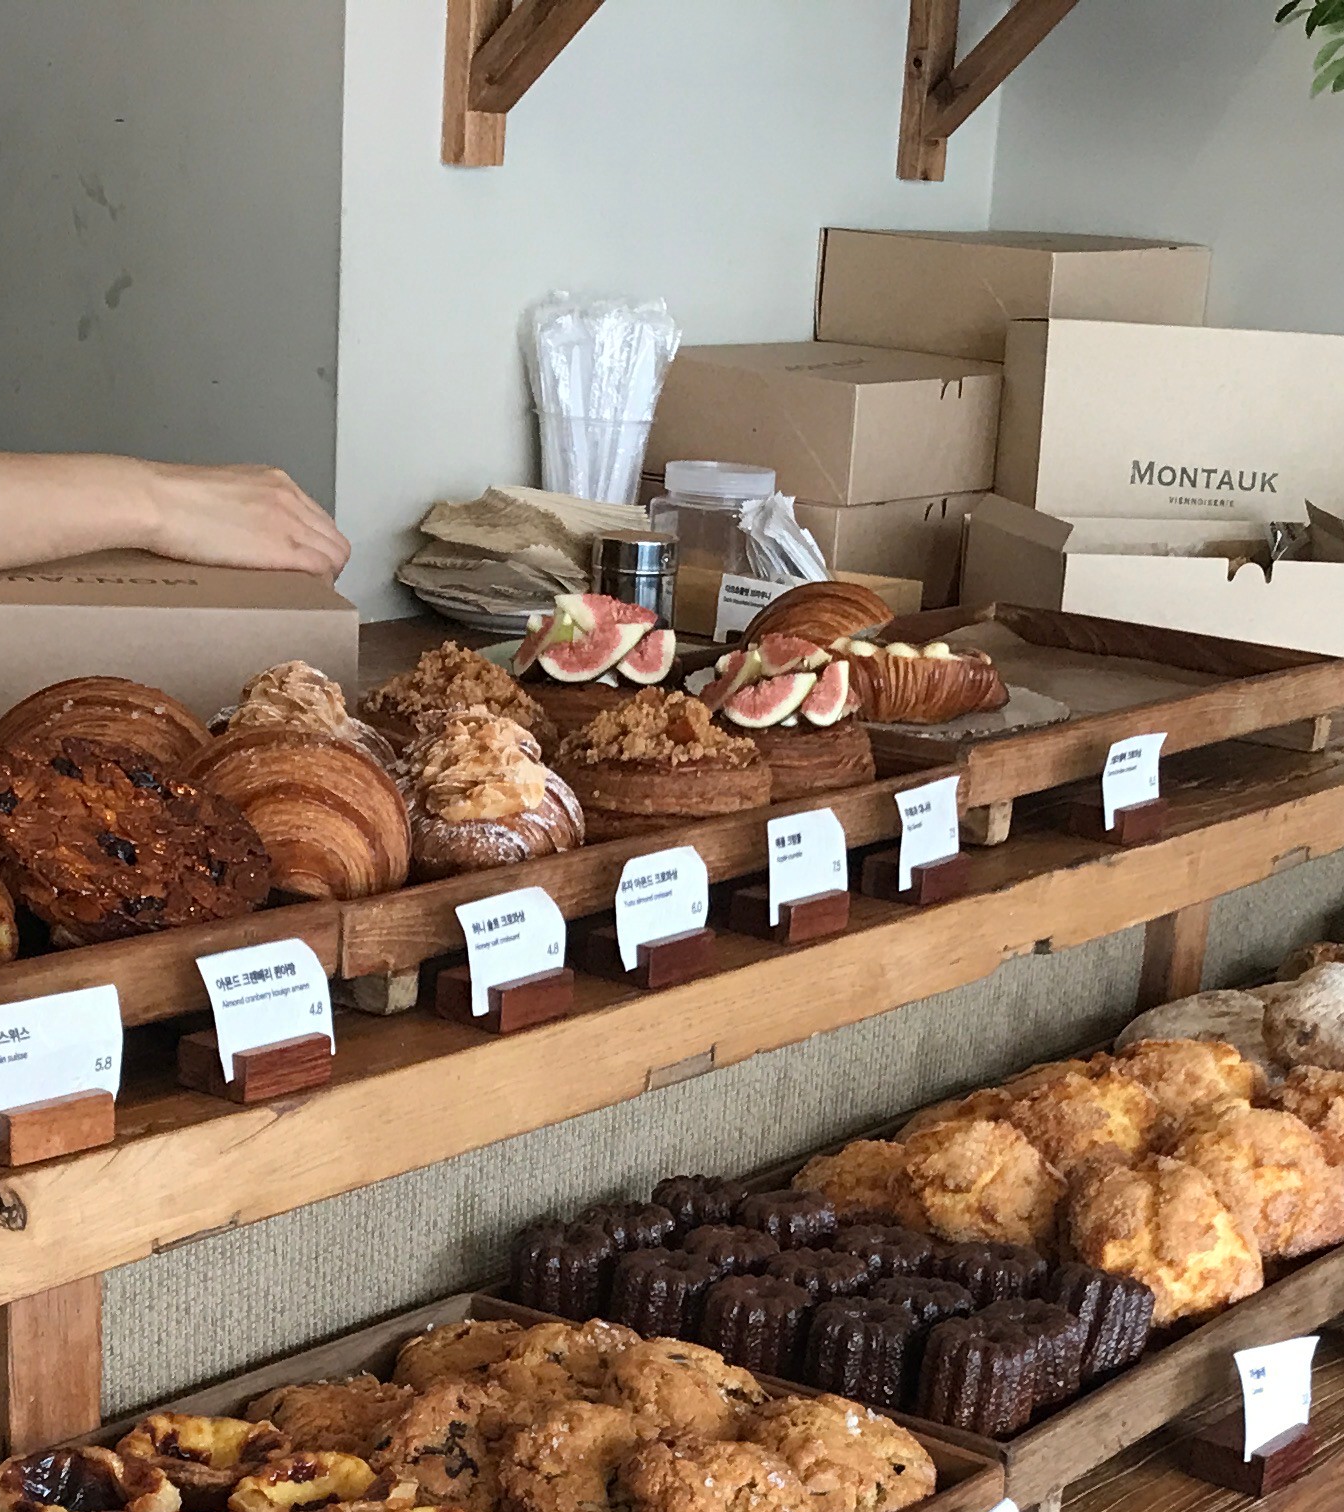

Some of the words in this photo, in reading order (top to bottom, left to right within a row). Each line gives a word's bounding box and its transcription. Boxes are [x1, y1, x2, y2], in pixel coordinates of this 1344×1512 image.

[1130, 460, 1278, 493] MONTAUK
[500, 909, 526, 927] 크로와상
[546, 941, 560, 955] 4.8
[215, 974, 242, 991] 아몬드
[222, 996, 245, 1009] Almond
[309, 1001, 323, 1015] 4.8
[94, 1056, 112, 1072] 5.8
